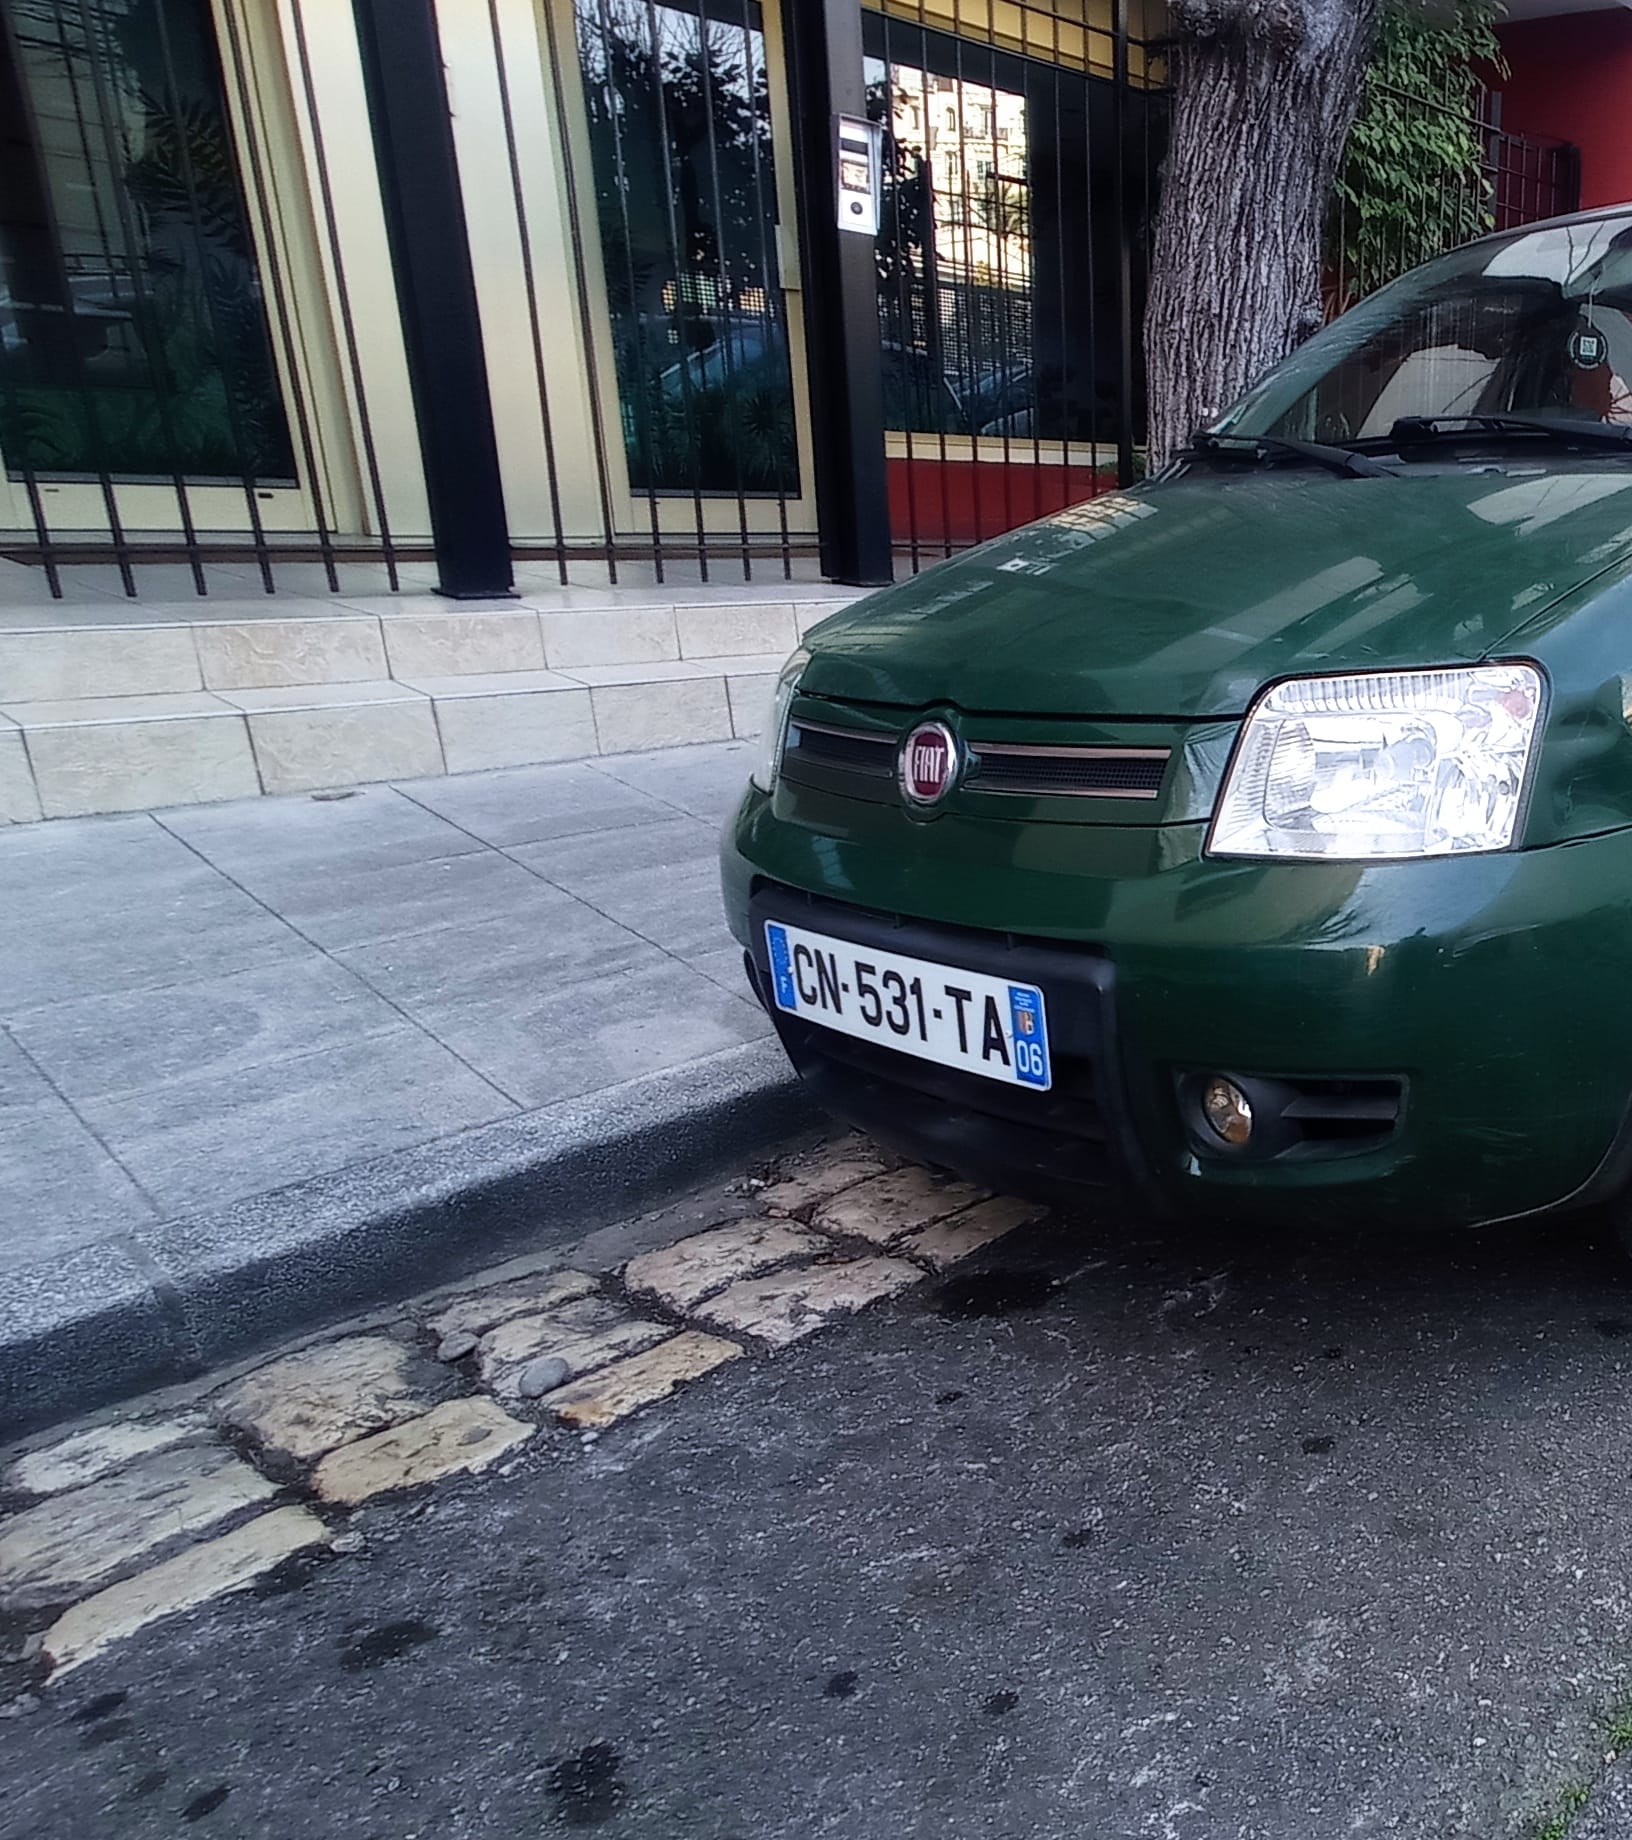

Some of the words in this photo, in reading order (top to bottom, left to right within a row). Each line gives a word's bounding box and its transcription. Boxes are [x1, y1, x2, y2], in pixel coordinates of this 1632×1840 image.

[914, 745, 945, 783] FIAT
[794, 943, 1011, 1067] CN-531-TA
[1016, 1039, 1044, 1076] 06
